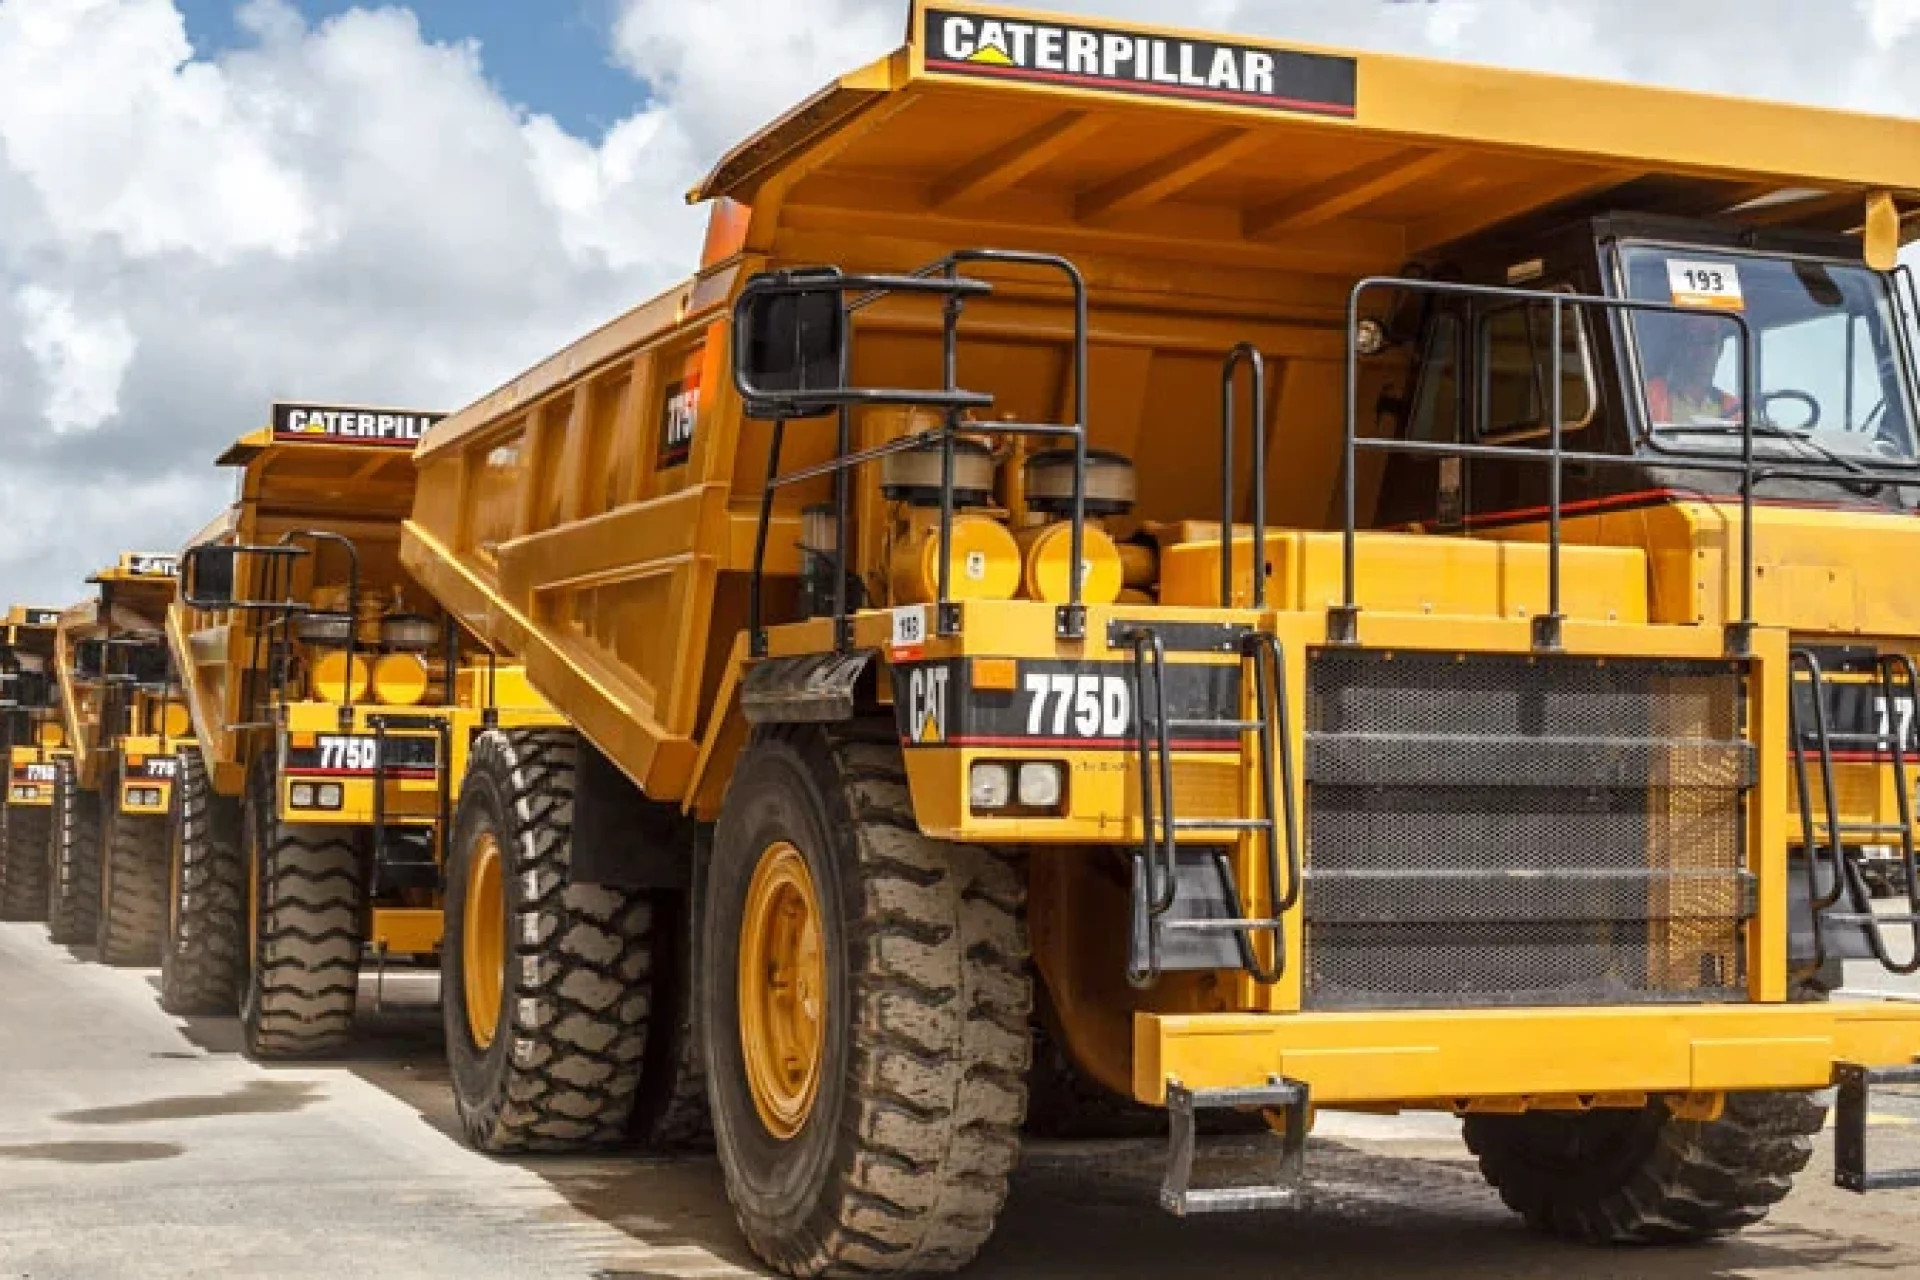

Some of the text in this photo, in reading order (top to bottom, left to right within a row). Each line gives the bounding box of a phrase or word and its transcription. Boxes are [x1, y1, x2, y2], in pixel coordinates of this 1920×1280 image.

[943, 17, 1275, 94] CATERPILLAR
[1683, 269, 1724, 291] 193
[910, 666, 948, 742] CAT
[1025, 673, 1130, 737] 775D
[1874, 696, 1919, 751] 77
[319, 736, 376, 768] 775D
